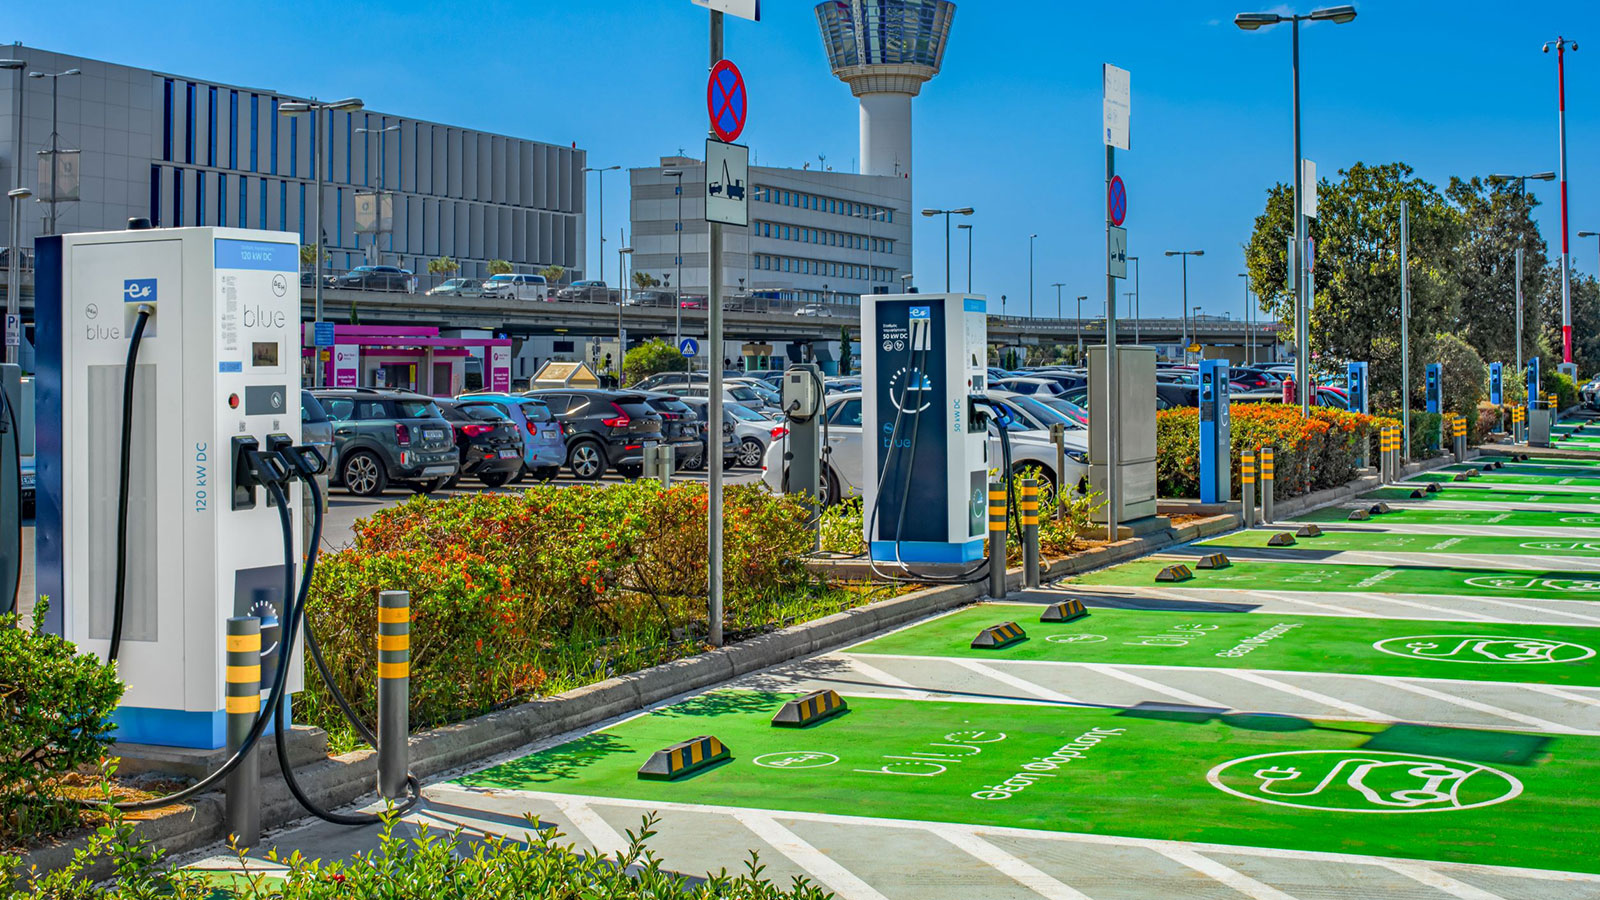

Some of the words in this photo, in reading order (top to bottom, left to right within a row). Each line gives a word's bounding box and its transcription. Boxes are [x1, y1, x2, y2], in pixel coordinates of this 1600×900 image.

[241, 251, 251, 260] 120
[252, 252, 261, 261] kW
[263, 252, 272, 261] DC
[243, 304, 286, 329] blue
[86, 324, 120, 340] blue
[195, 442, 207, 461] DC
[884, 437, 911, 448] bue
[195, 465, 207, 487] kW
[195, 490, 207, 512] 120
[853, 730, 1007, 777] blue
